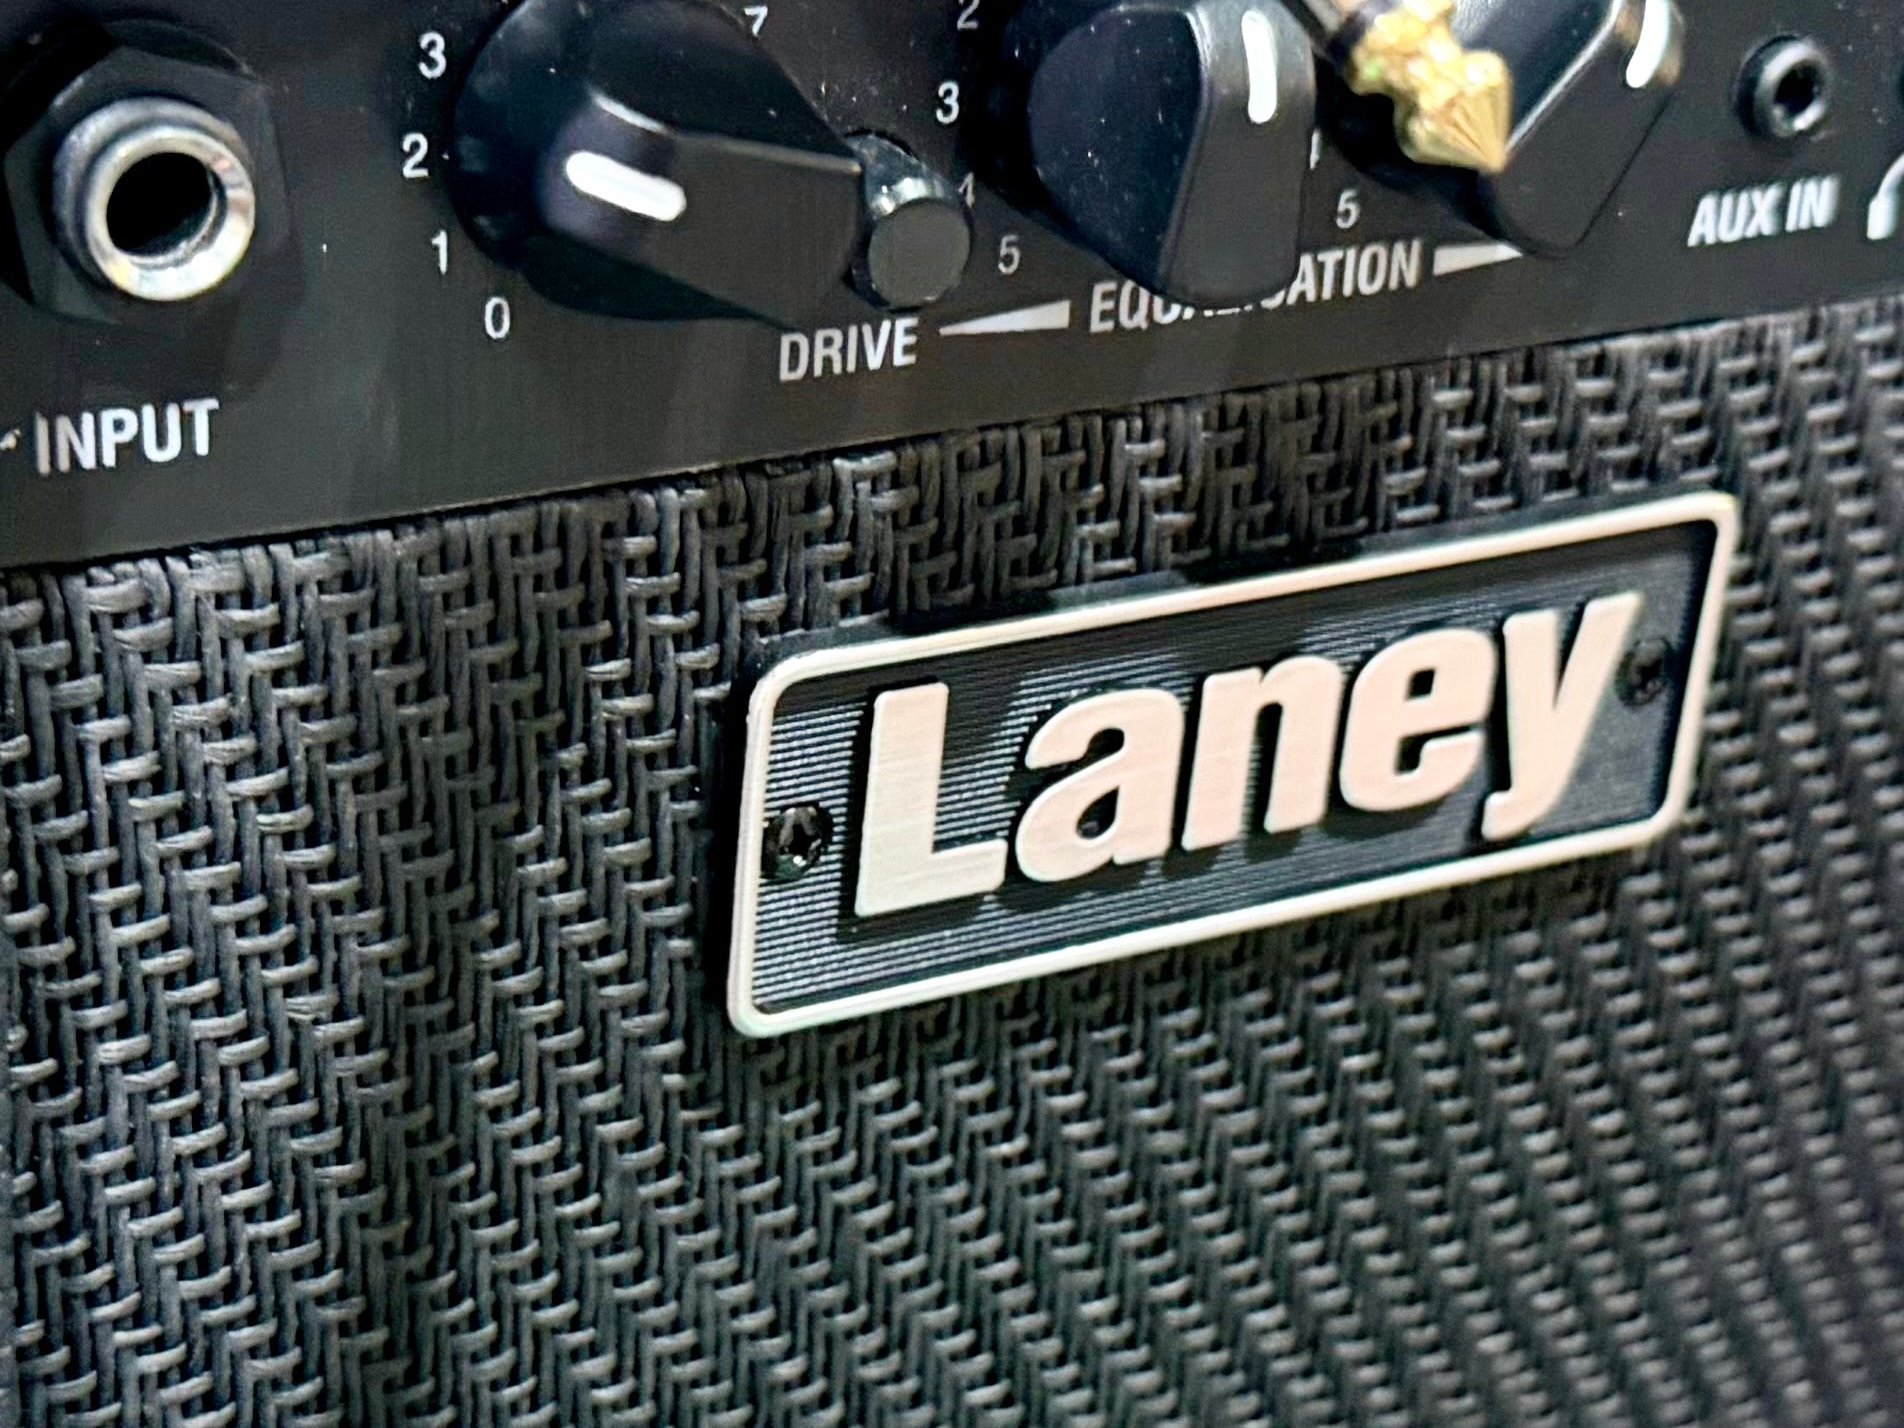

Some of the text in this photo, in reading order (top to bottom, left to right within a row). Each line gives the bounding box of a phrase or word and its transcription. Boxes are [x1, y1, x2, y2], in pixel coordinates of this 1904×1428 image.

[742, 4, 769, 37] 7
[417, 30, 448, 80] 3
[934, 80, 961, 125] 3
[401, 131, 430, 180] 2
[1335, 189, 1361, 230] 5
[1686, 176, 1839, 248] AUX IN
[430, 229, 449, 275] 1
[997, 234, 1021, 275] 5
[483, 295, 512, 341] 0
[778, 316, 919, 382] DRIVE
[36, 397, 220, 474] INPUT
[853, 590, 1644, 920] Laney
